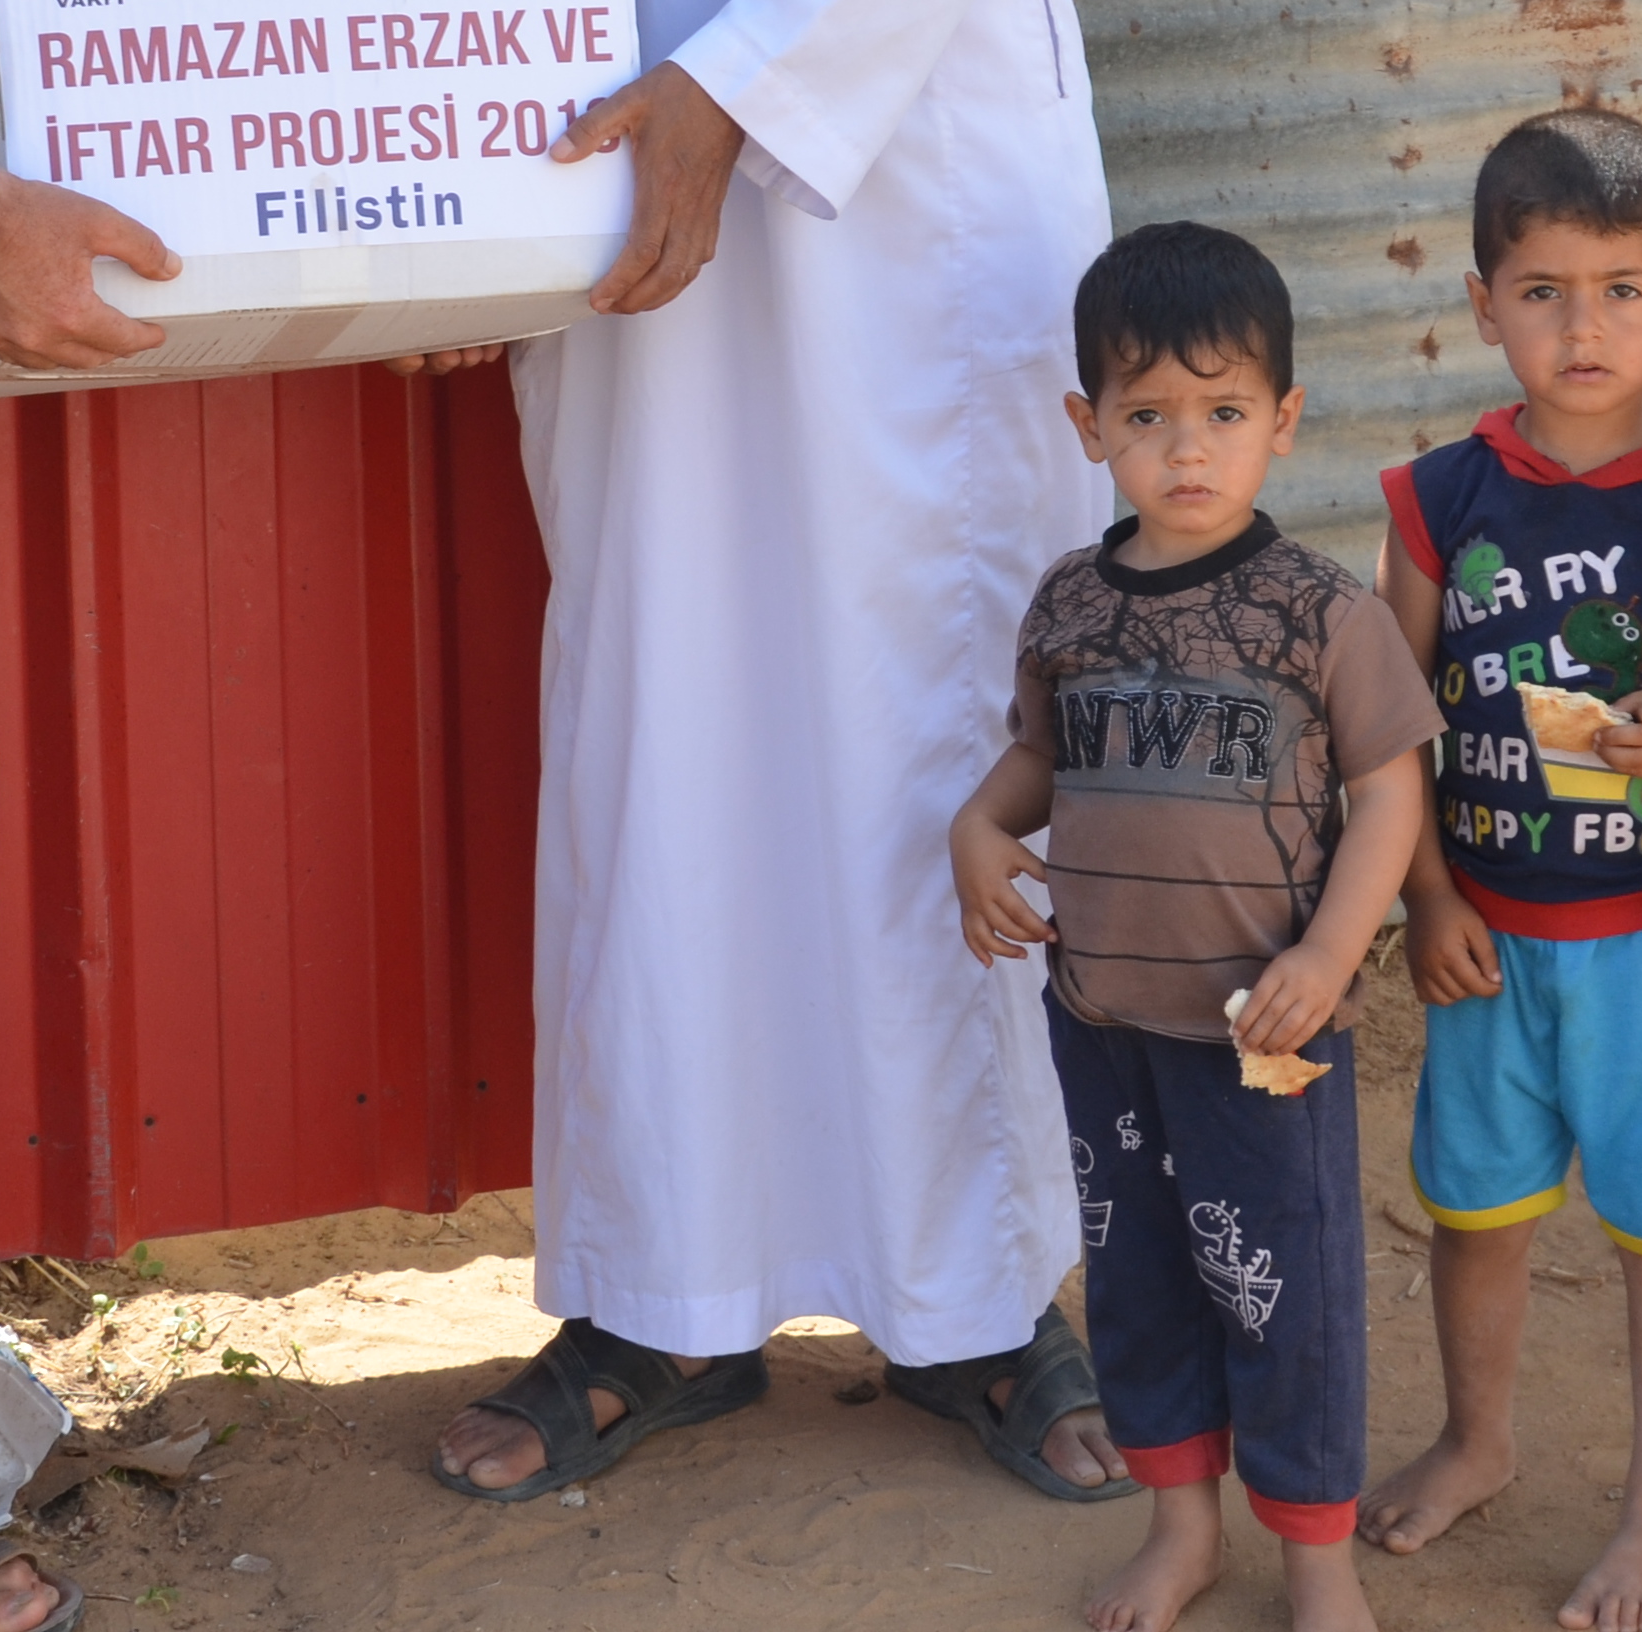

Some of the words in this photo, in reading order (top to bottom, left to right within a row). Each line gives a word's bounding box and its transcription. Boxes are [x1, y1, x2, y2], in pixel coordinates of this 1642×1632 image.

[37, 17, 329, 89] RAMAZAN
[347, 9, 531, 72] ERZAK
[542, 7, 613, 63] VE
[46, 114, 213, 183] İFTAR
[231, 93, 459, 171] PROJESİ
[255, 182, 463, 237] Filistin
[1054, 687, 1276, 783] NWR
